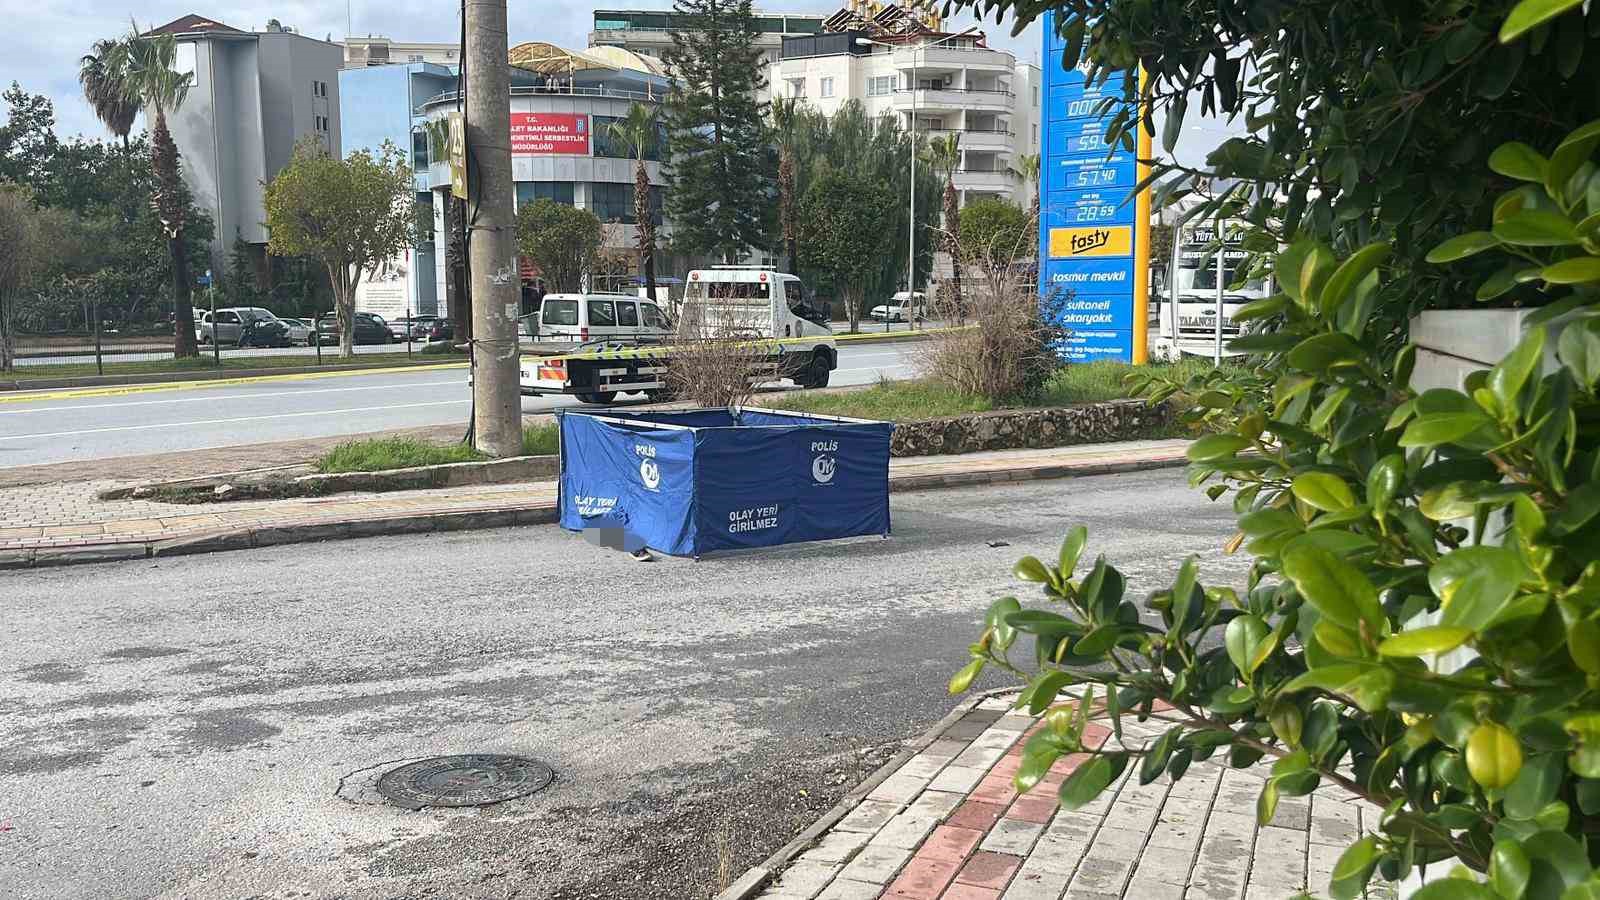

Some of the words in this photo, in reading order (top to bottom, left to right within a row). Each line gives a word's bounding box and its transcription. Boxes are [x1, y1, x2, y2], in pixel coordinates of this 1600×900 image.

[1071, 229, 1110, 255] fasty
[1053, 272, 1090, 281] tosmur
[636, 444, 656, 458] POLİS
[811, 440, 839, 452] POLİS
[729, 509, 755, 521] OLAY
[756, 503, 779, 517] YERİ
[728, 518, 778, 533] GİRİLMEZ
